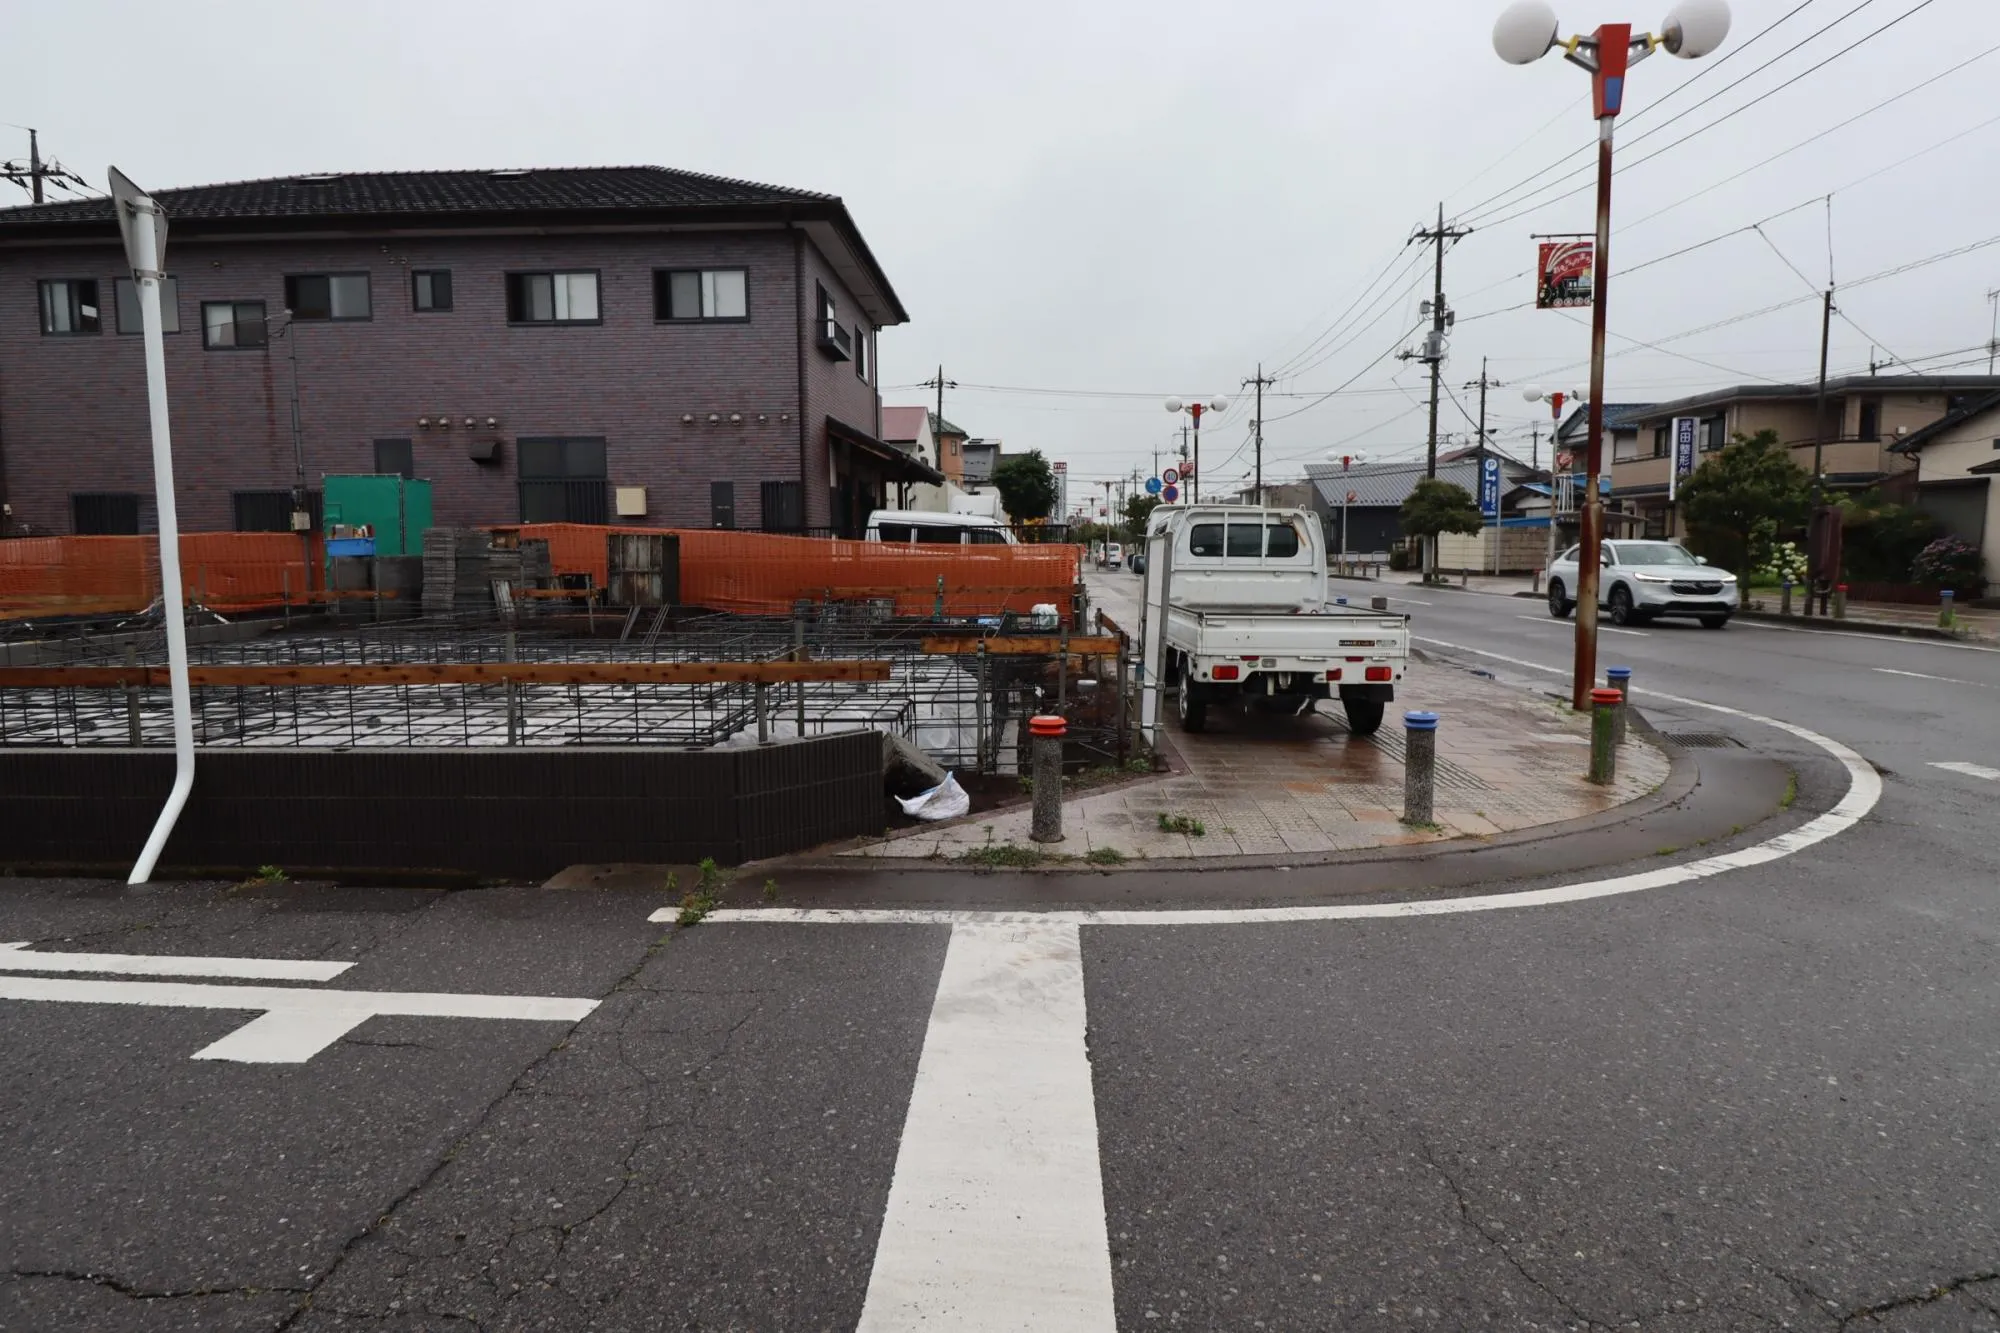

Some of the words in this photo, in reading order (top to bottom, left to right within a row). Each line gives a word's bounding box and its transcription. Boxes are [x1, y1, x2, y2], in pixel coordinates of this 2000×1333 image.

[1679, 420, 1691, 483] 武田整形外
[1166, 472, 1175, 480] 40
